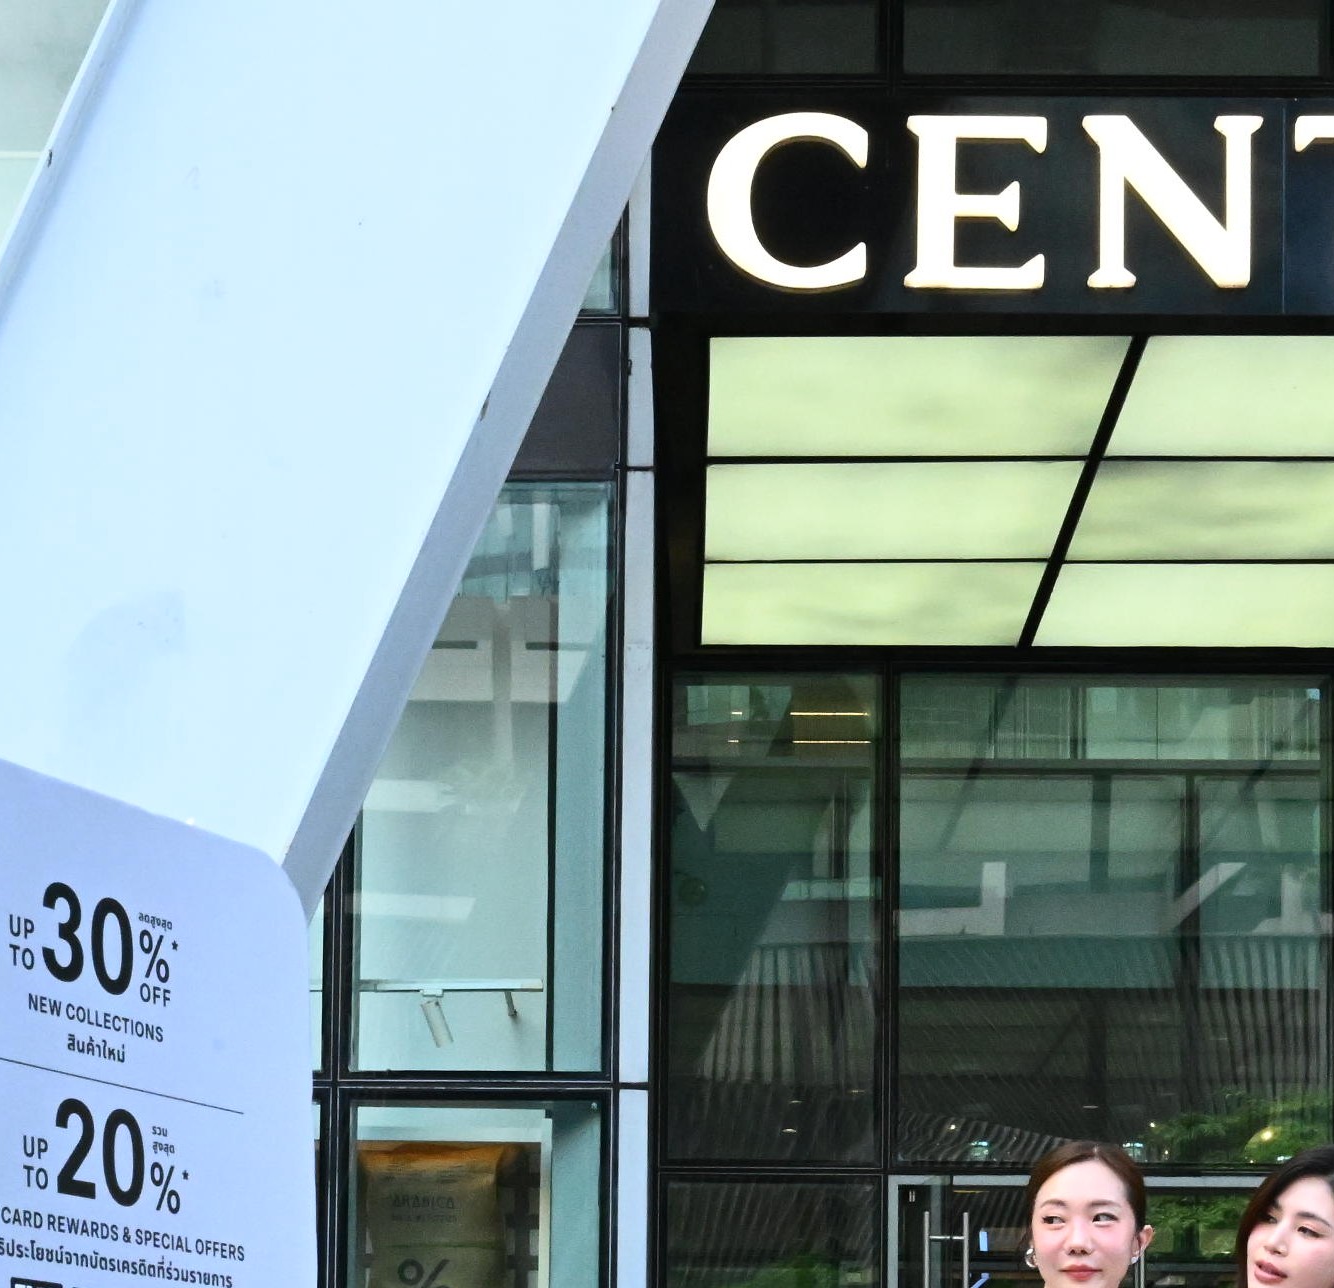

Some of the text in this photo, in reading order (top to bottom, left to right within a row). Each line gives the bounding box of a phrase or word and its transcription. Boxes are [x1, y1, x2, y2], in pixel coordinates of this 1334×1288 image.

[8, 913, 35, 940] UP
[8, 943, 35, 971] TO
[139, 982, 172, 1008] OFF
[27, 992, 164, 1043] NEW COLLECTIONS
[66, 1033, 126, 1064] สินค้าใหม่
[22, 1134, 49, 1160] UP
[22, 1164, 49, 1190] TO
[1, 1206, 44, 1230] CARD
[47, 1212, 119, 1242] REWARDS
[122, 1226, 132, 1244] &
[135, 1228, 192, 1255] SPECIAL
[194, 1238, 245, 1262] OFFERS
